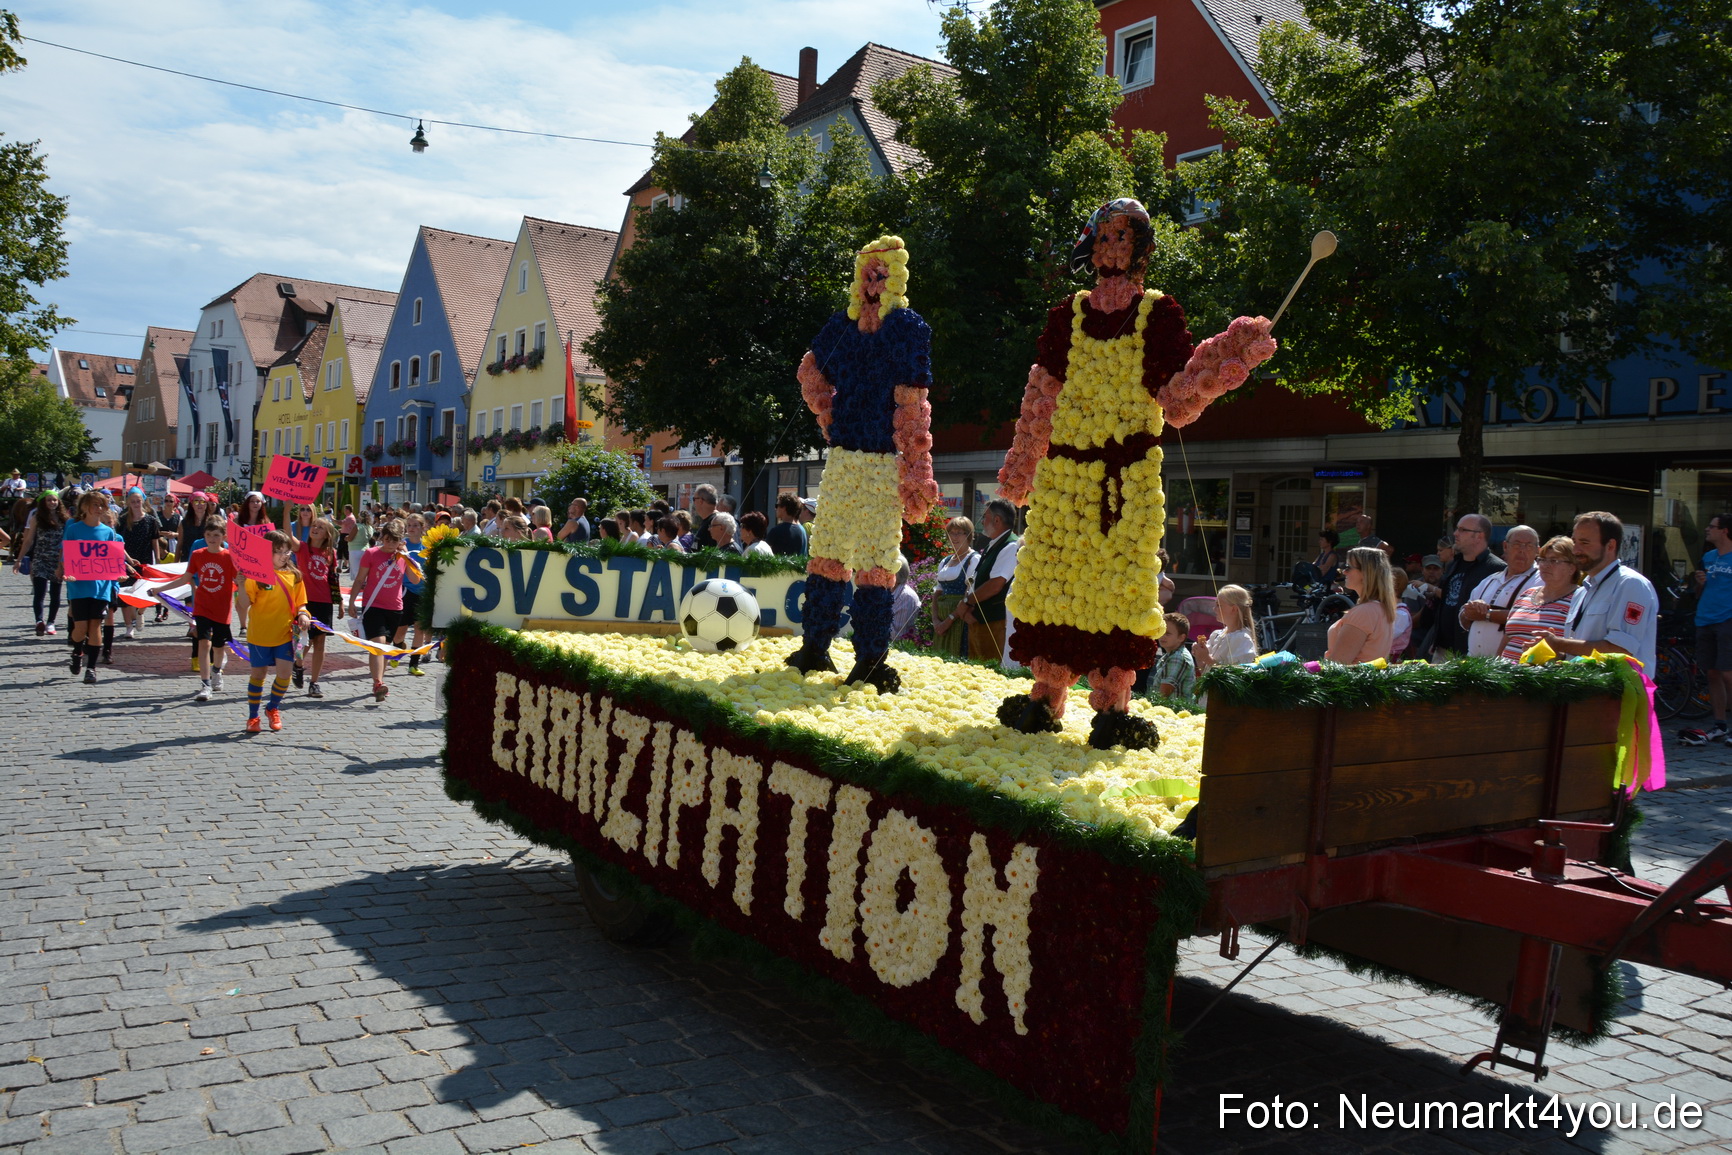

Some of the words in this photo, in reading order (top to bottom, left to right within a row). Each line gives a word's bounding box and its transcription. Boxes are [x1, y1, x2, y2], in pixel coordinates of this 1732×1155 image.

[1403, 381, 1612, 428] ANTON
[287, 461, 320, 483] U11
[79, 542, 109, 558] U13
[71, 558, 126, 575] MEISTER
[460, 547, 549, 616] SV
